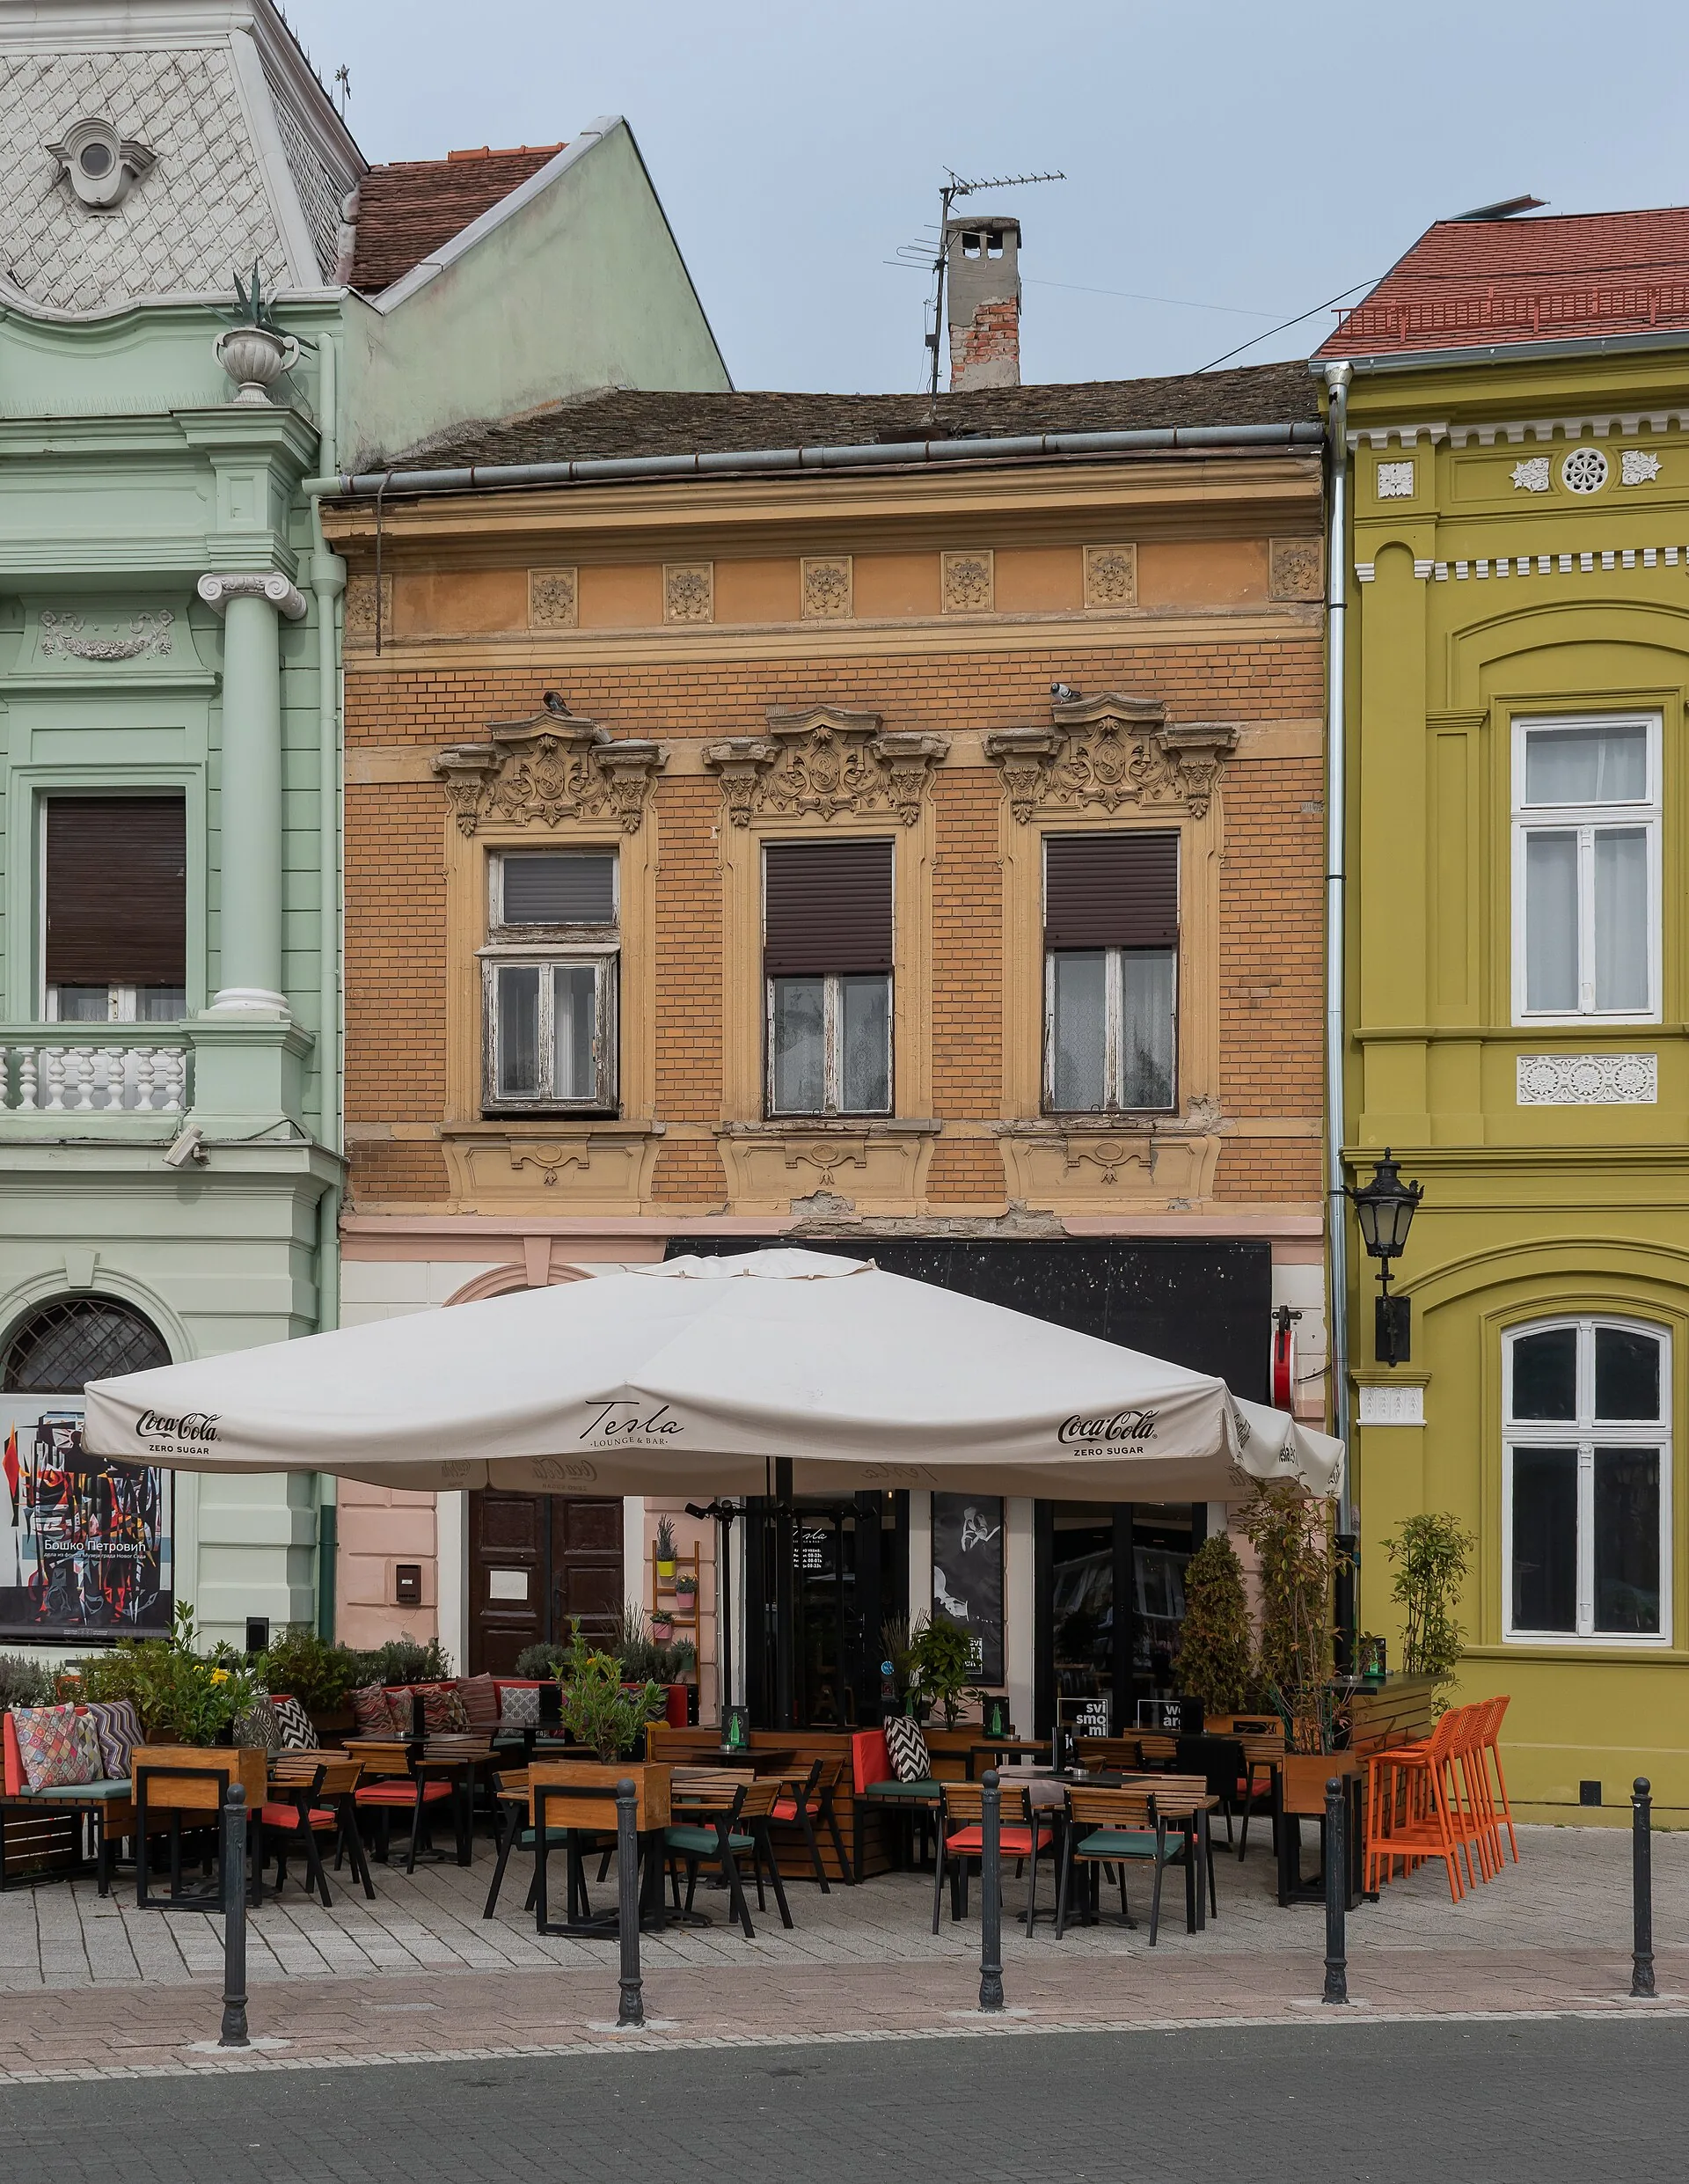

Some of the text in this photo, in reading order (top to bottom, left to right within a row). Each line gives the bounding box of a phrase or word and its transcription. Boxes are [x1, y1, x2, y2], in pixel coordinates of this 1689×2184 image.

[135, 1410, 223, 1441] Coca-Cola
[579, 1400, 684, 1439] Tesla
[1057, 1410, 1160, 1444] Coca-Cola
[177, 1446, 209, 1455] SUGAR
[793, 1525, 827, 1540] Tsla
[44, 1540, 146, 1554] Бошко Петровић
[1086, 1701, 1106, 1713] svi
[1166, 1705, 1181, 1715] w
[1076, 1714, 1107, 1725] smo
[1163, 1717, 1181, 1726] ar
[1088, 1724, 1107, 1736] mi
